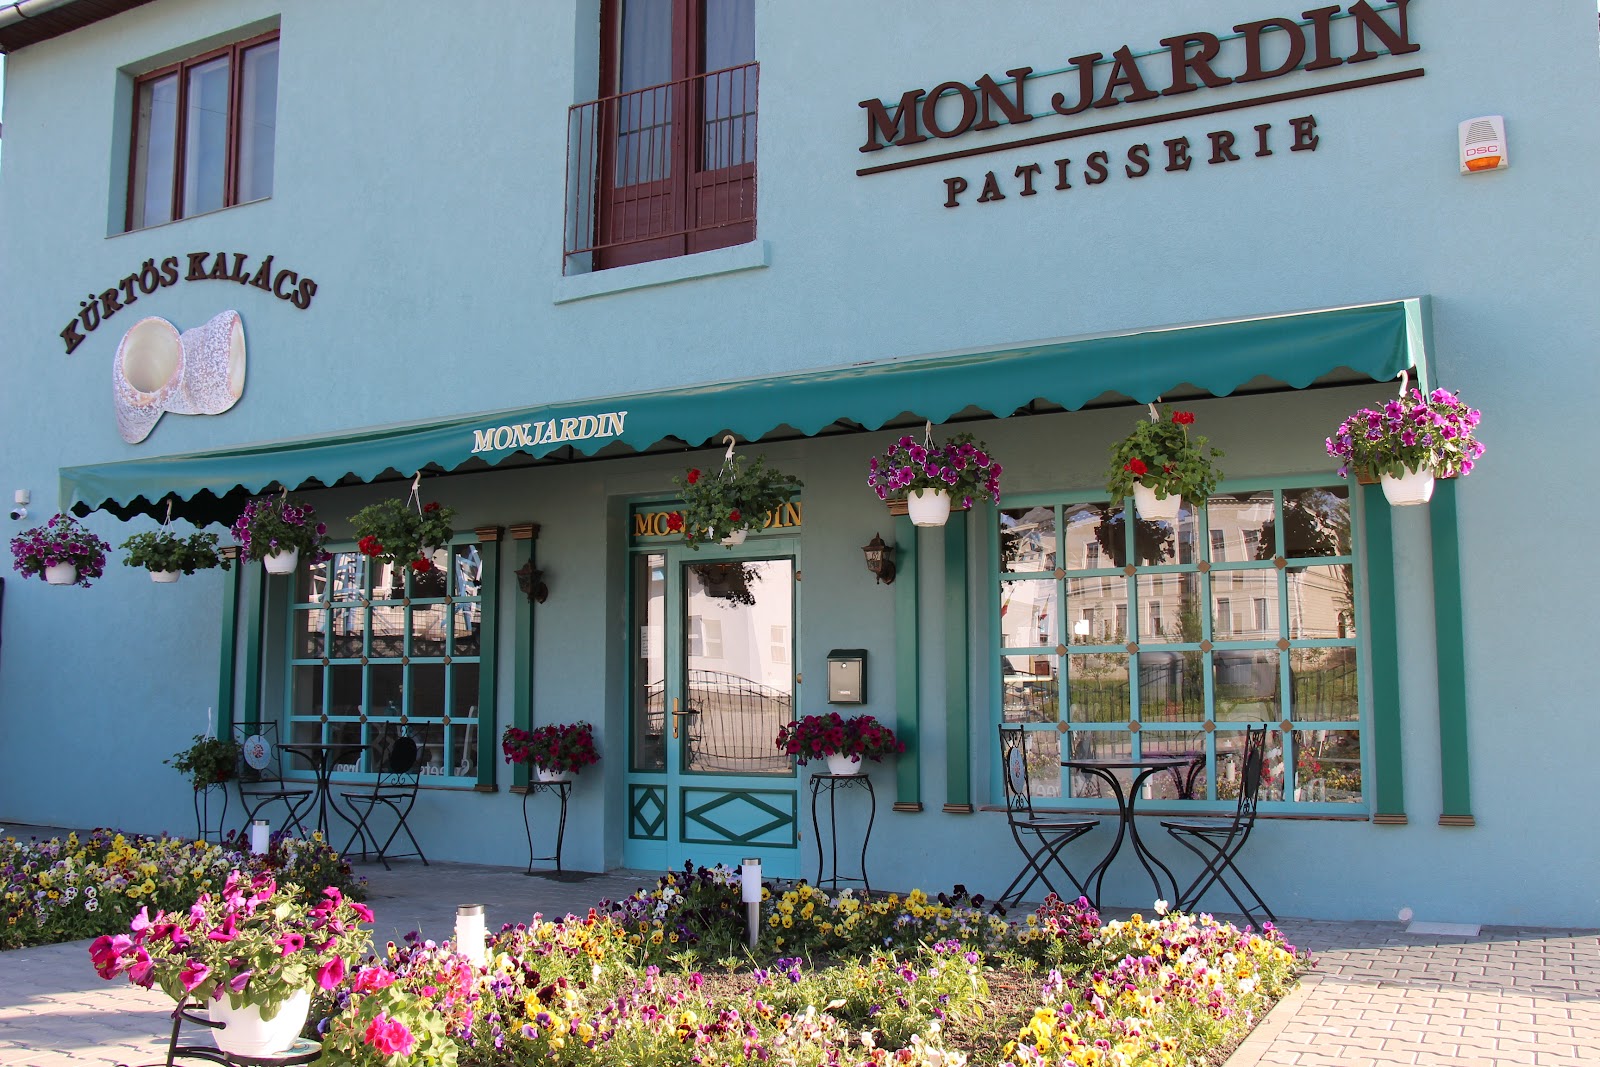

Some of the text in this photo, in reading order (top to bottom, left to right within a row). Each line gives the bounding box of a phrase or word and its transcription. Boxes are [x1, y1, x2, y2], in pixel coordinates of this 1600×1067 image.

[858, 0, 1421, 154] MON JARDIN
[943, 114, 1320, 209] PATISSERIE
[1466, 145, 1498, 157] DSC
[59, 251, 318, 355] KÜRTÖS KALÁCS
[471, 411, 628, 453] MONJARDIN
